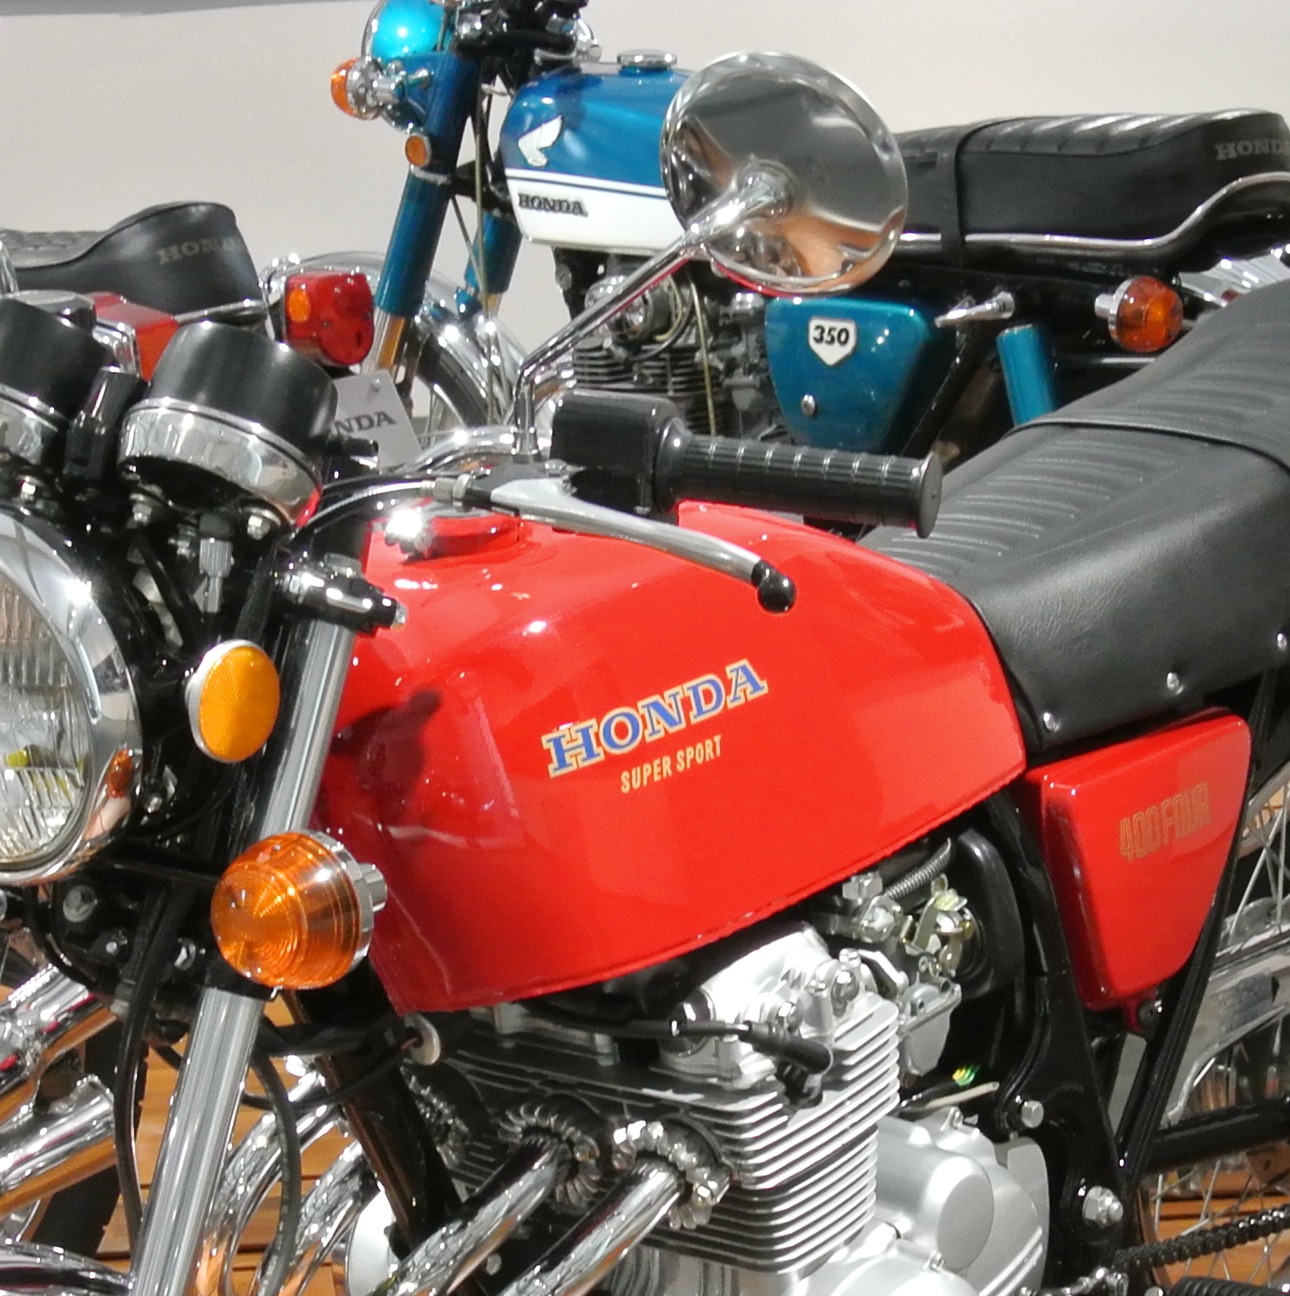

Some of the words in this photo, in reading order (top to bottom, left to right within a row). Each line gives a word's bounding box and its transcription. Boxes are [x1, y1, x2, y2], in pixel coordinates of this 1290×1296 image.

[518, 193, 589, 217] HONDA
[813, 325, 850, 346] 350
[334, 411, 397, 434] NDA
[541, 658, 769, 779] HONDA
[620, 756, 672, 794] SUPER
[676, 734, 722, 772] SPORT
